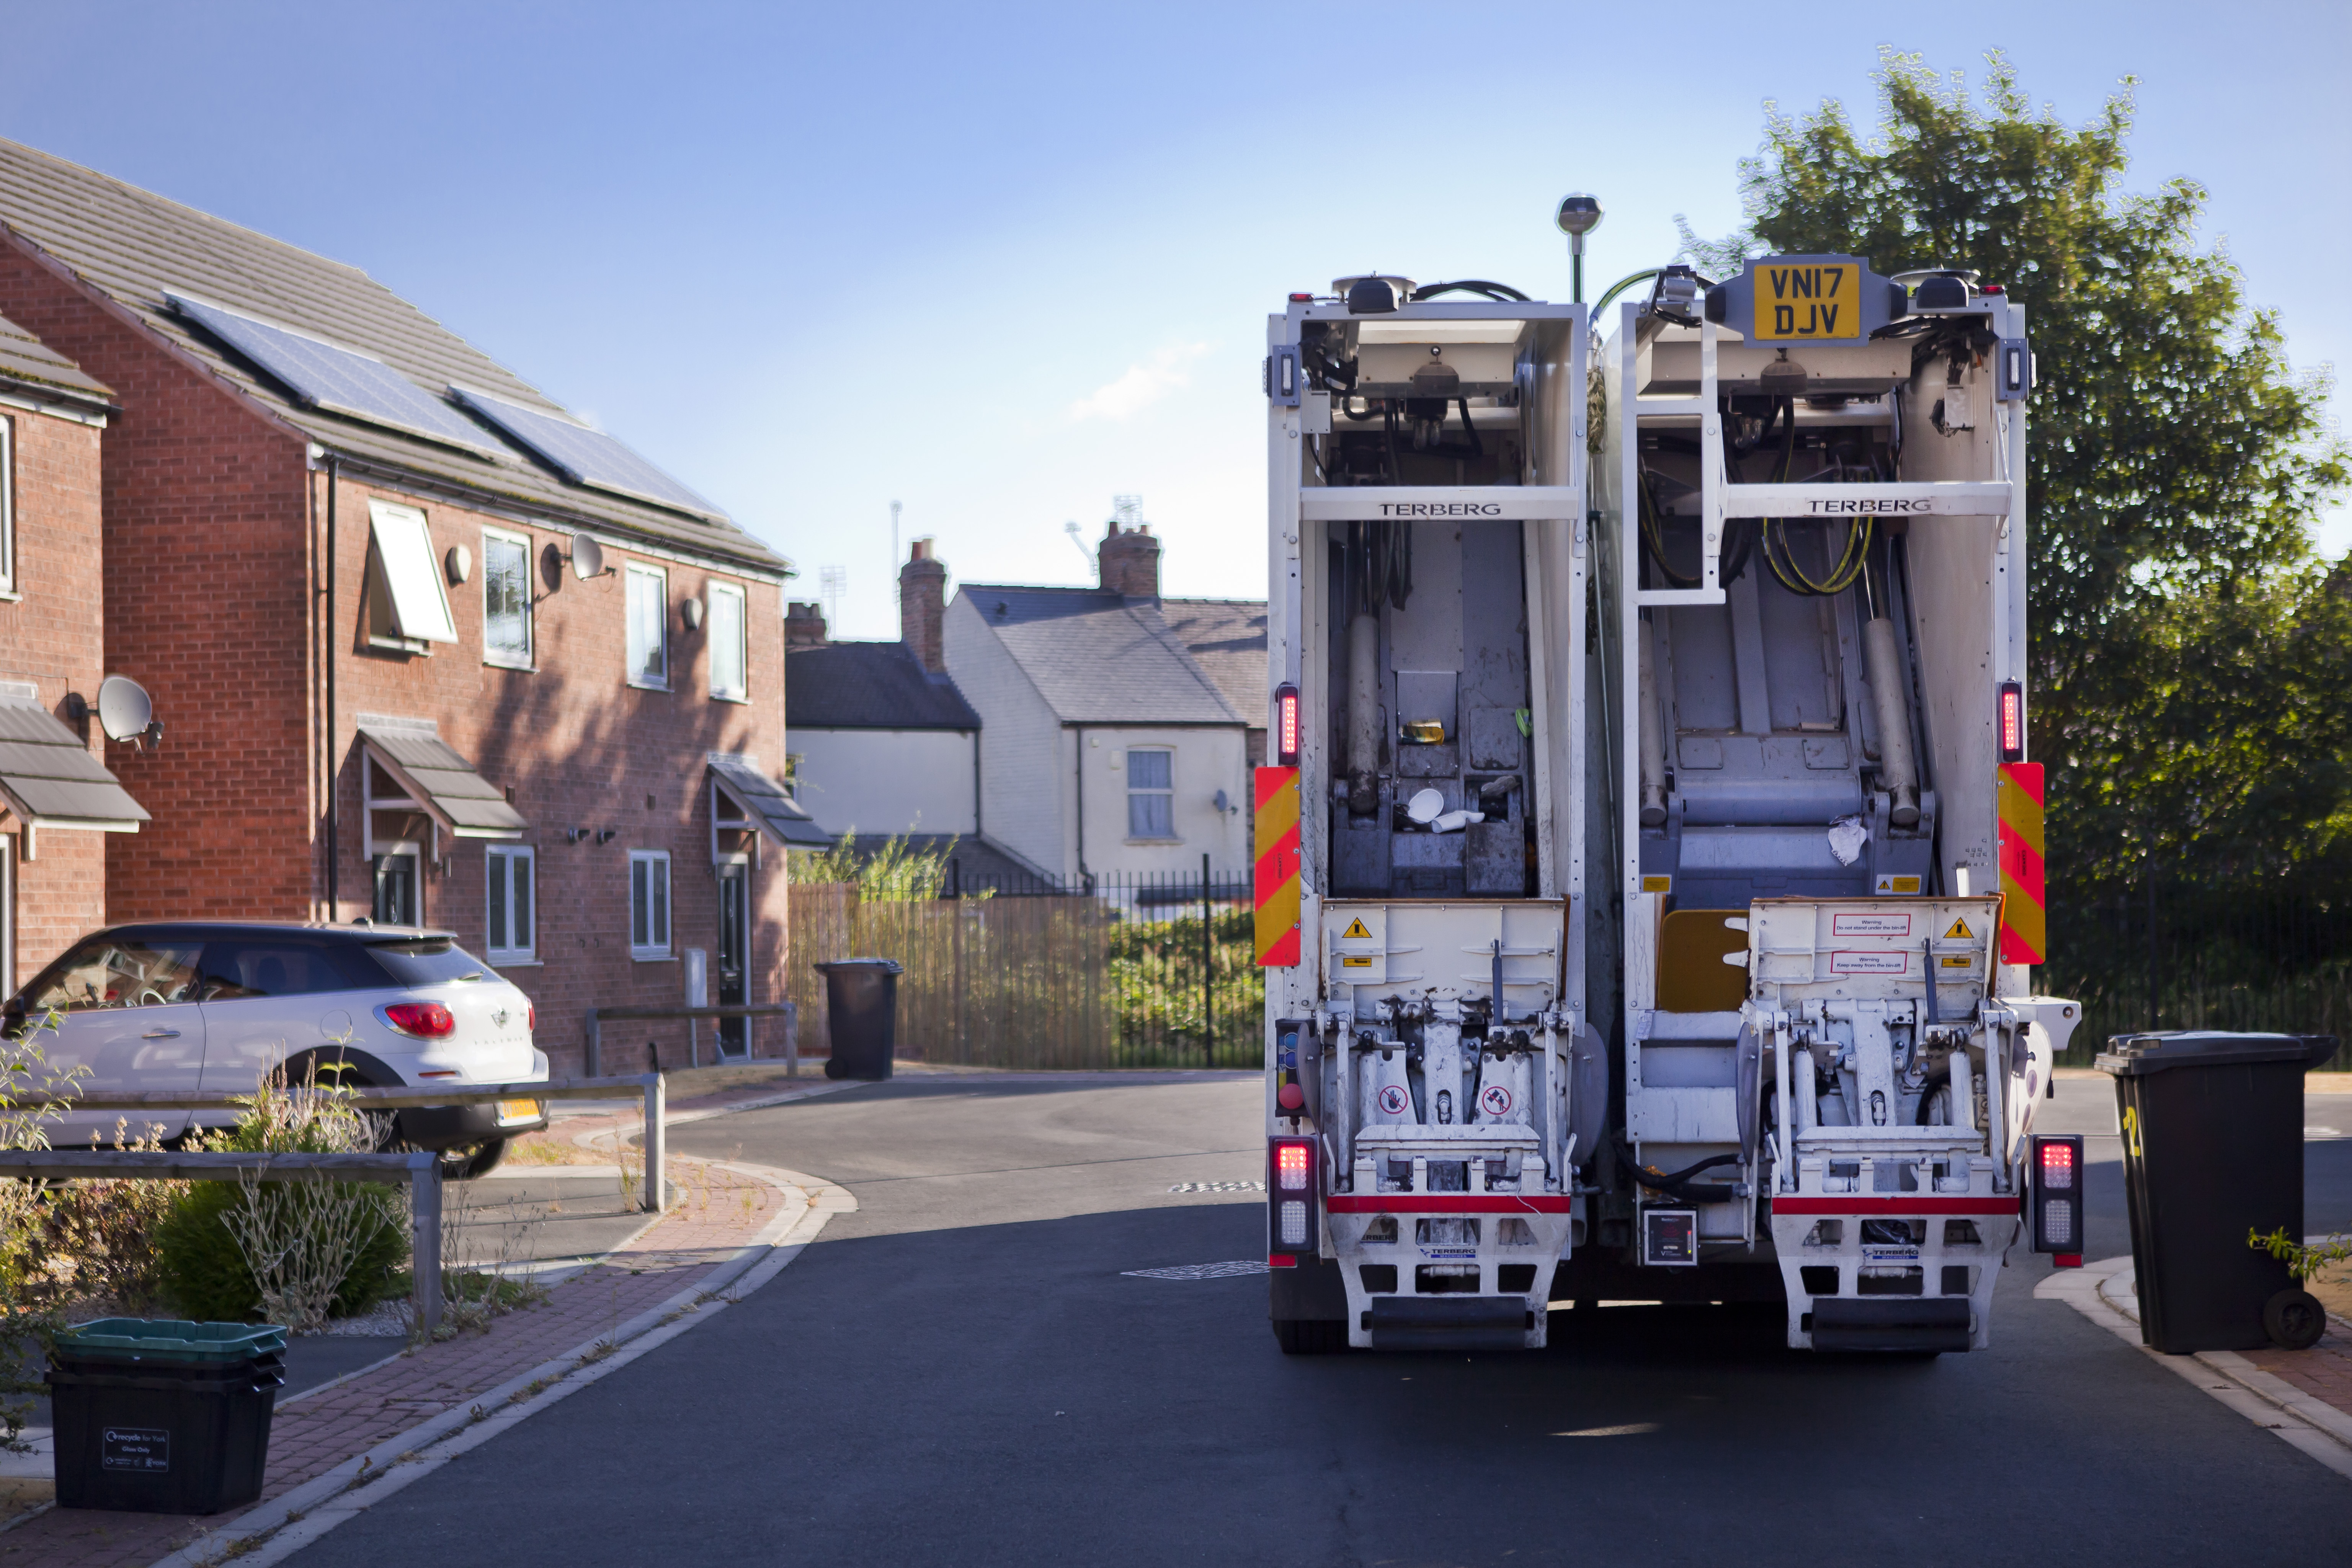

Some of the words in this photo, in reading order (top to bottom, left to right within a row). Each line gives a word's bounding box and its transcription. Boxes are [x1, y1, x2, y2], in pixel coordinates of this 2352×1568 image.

[1769, 268, 1843, 299] VN17
[1774, 304, 1839, 335] DJV
[1378, 503, 1501, 516] TERBERG
[1807, 499, 1932, 513] TERBERG
